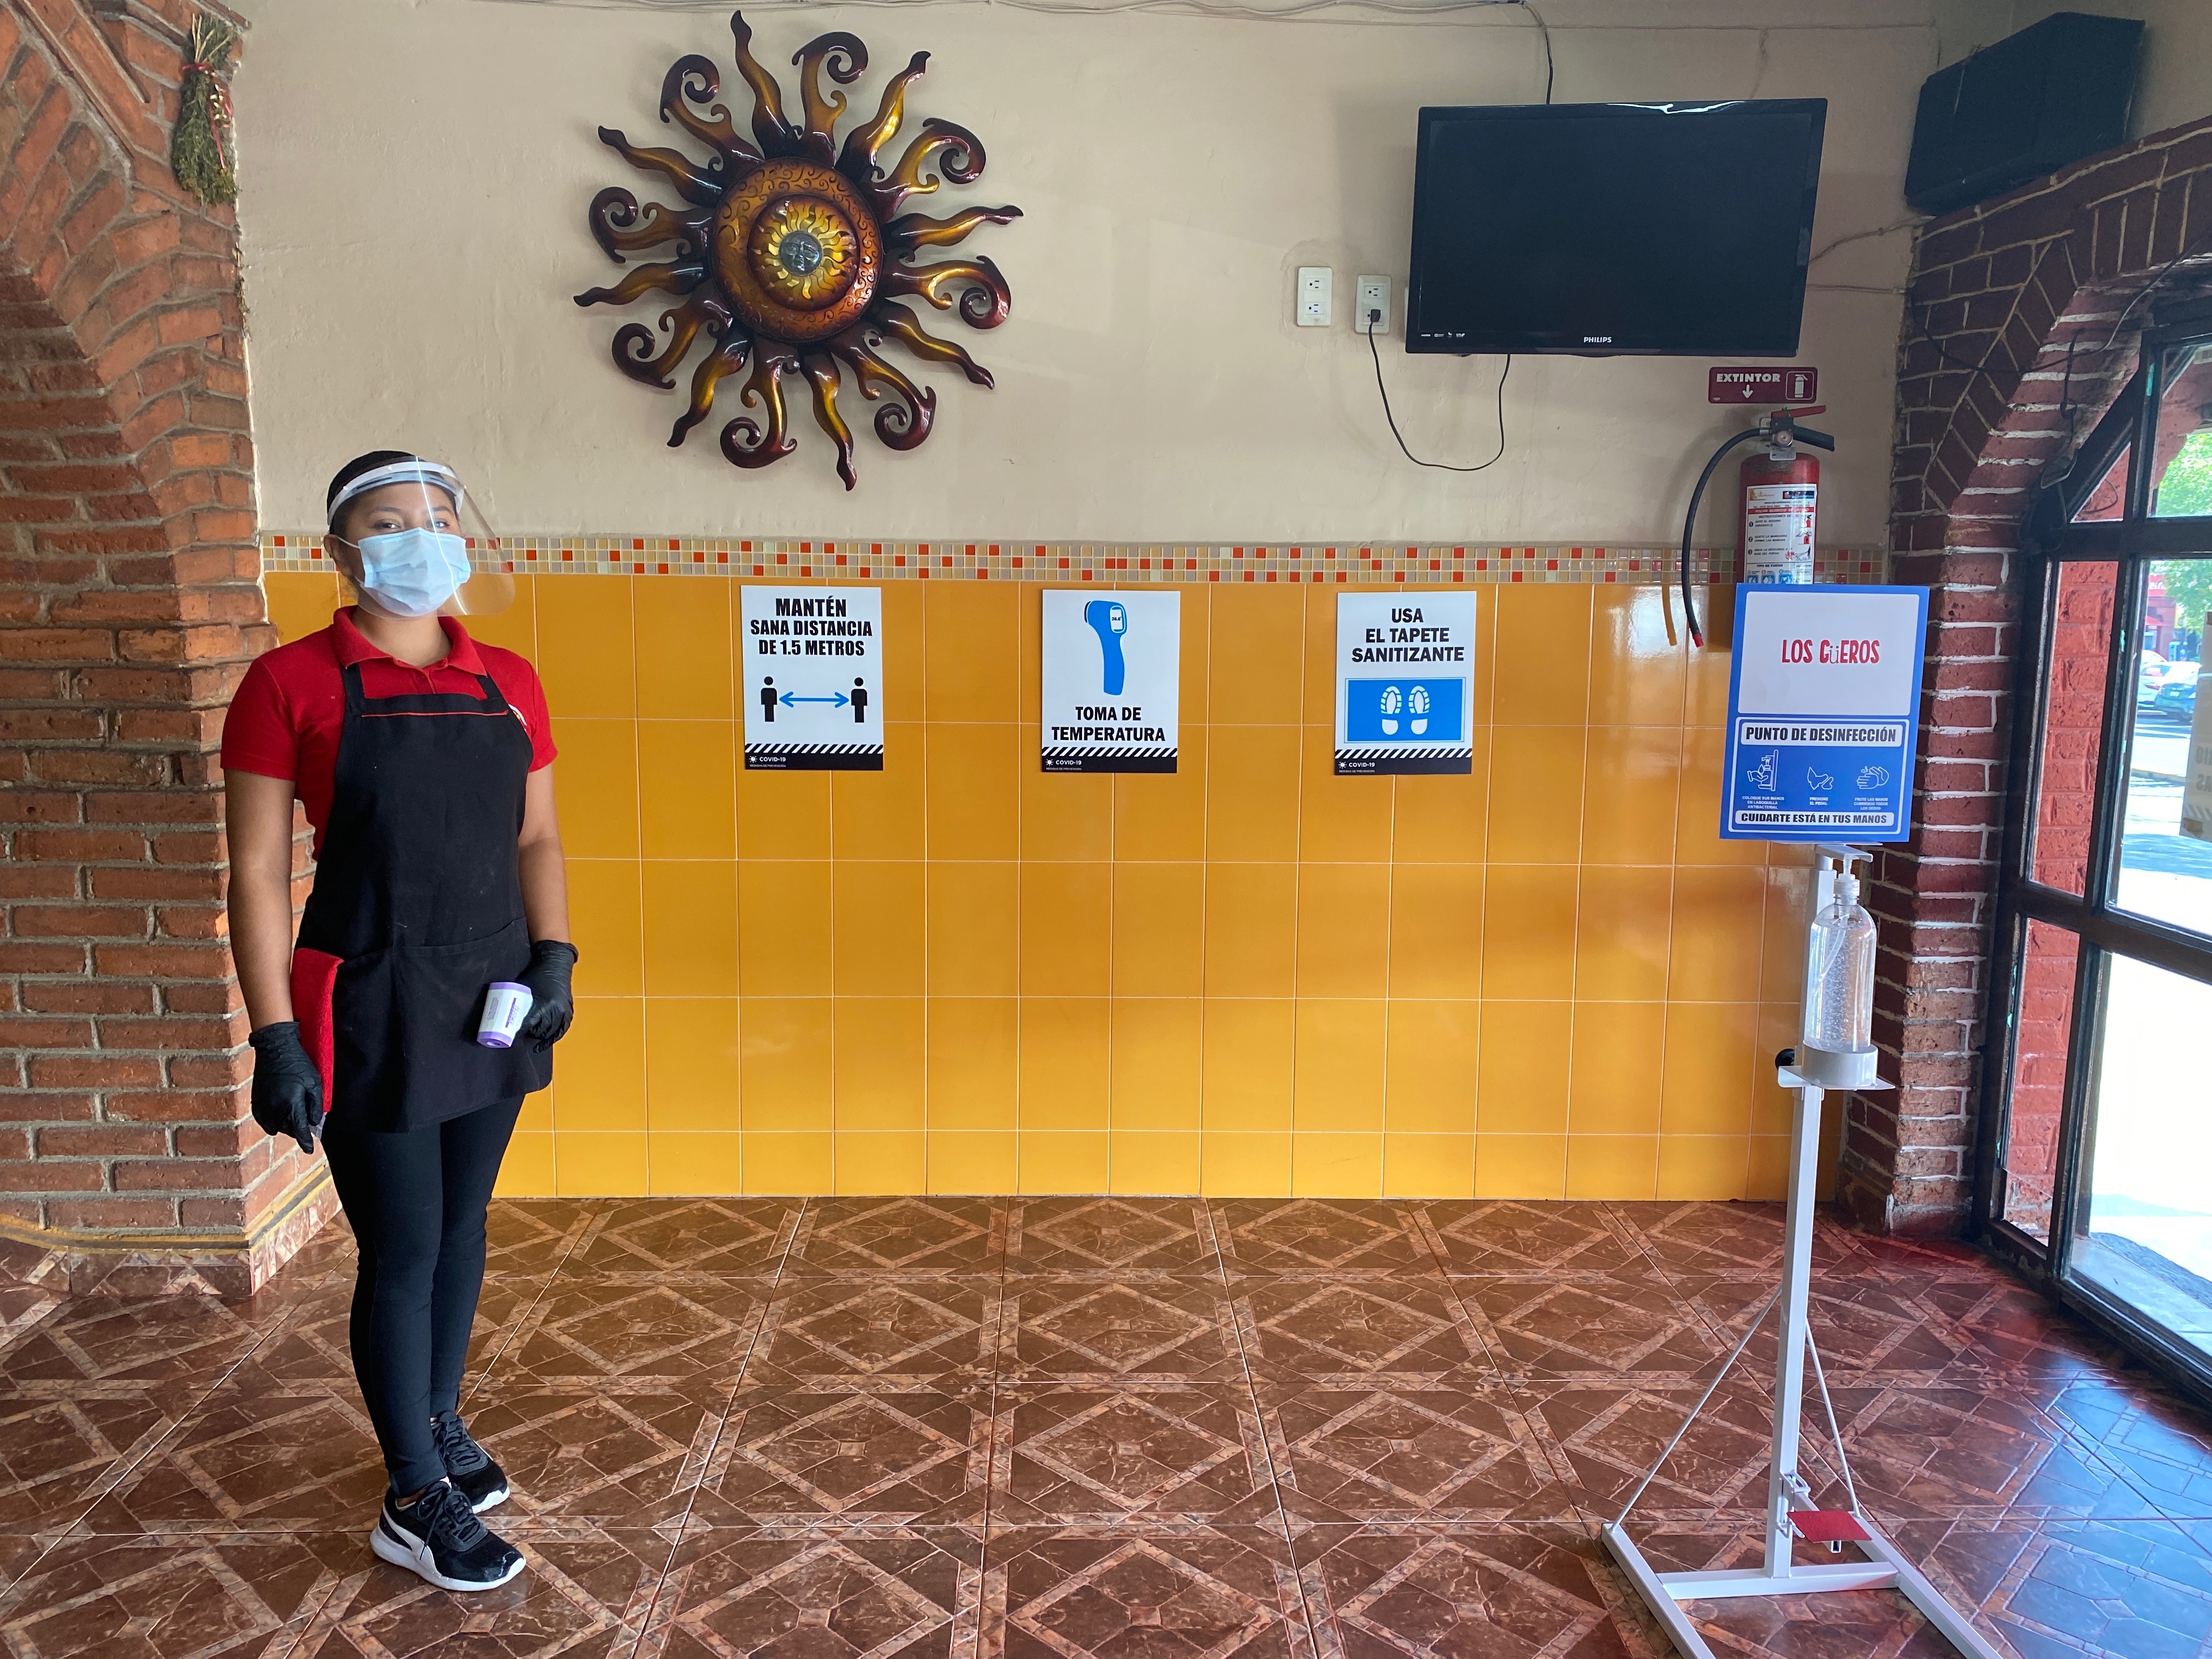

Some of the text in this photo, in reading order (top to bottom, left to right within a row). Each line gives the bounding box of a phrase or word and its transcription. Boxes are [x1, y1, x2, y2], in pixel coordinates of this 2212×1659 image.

[1716, 373, 1781, 382] EXTINTOR
[775, 595, 847, 617] MANTÉN
[1391, 608, 1424, 623] USA
[751, 619, 873, 636] SANA DISTANCIA
[1365, 627, 1449, 643] EL TAPETE
[759, 640, 865, 656] DE 1.5 METROS
[1351, 646, 1465, 663] SANITIZANTE
[1781, 639, 1813, 663] LOS
[1075, 706, 1142, 721] TOMA DE
[1051, 726, 1166, 741] TEMPERATURA
[1746, 726, 1897, 742] PUNTO DE DESINFECCIÓN
[1741, 812, 1887, 823] CUIDARTE ESTÁ EN TUS MANOS
